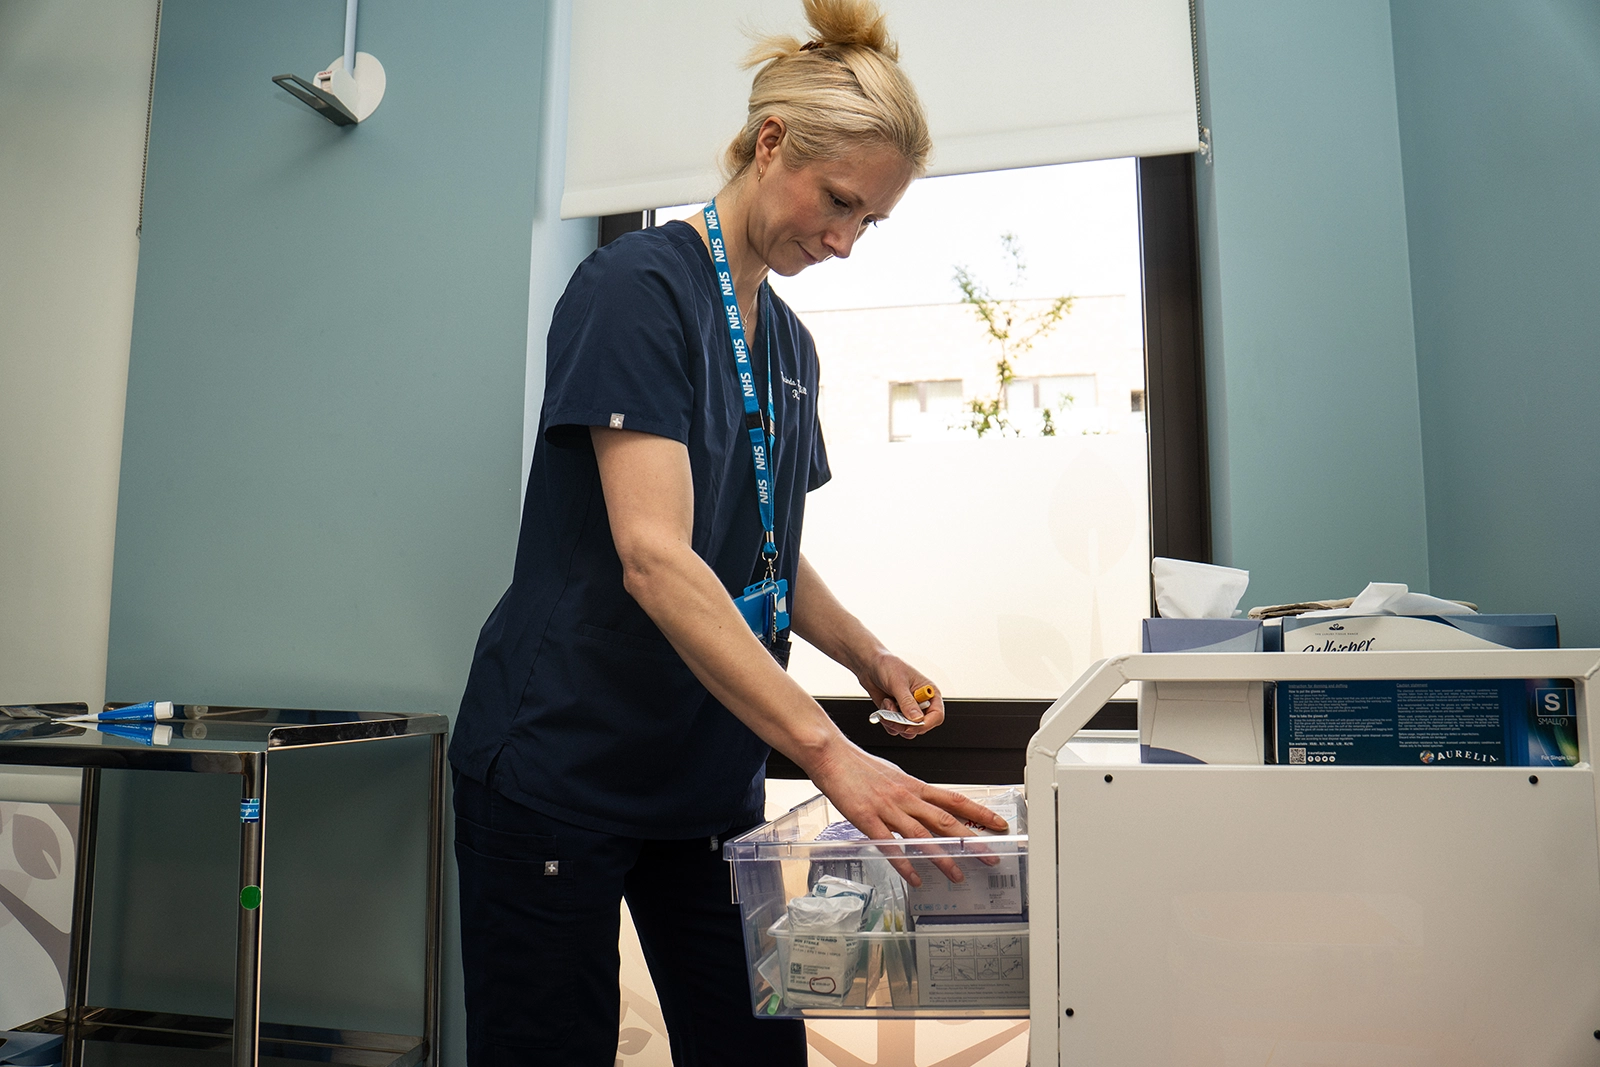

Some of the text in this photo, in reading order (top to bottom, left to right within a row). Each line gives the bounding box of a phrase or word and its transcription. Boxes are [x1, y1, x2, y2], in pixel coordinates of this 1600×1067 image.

[706, 210, 718, 230] NHS
[712, 237, 726, 262] NHS
[718, 271, 734, 296] NHS
[726, 304, 740, 330] NHS
[733, 338, 748, 362] NHS
[740, 372, 754, 396] NHS
[753, 445, 766, 470] NHS
[757, 479, 768, 504] NHS
[1544, 693, 1560, 711] S
[1538, 717, 1568, 726] SMALL(7)
[1437, 750, 1497, 762] AURELIA
